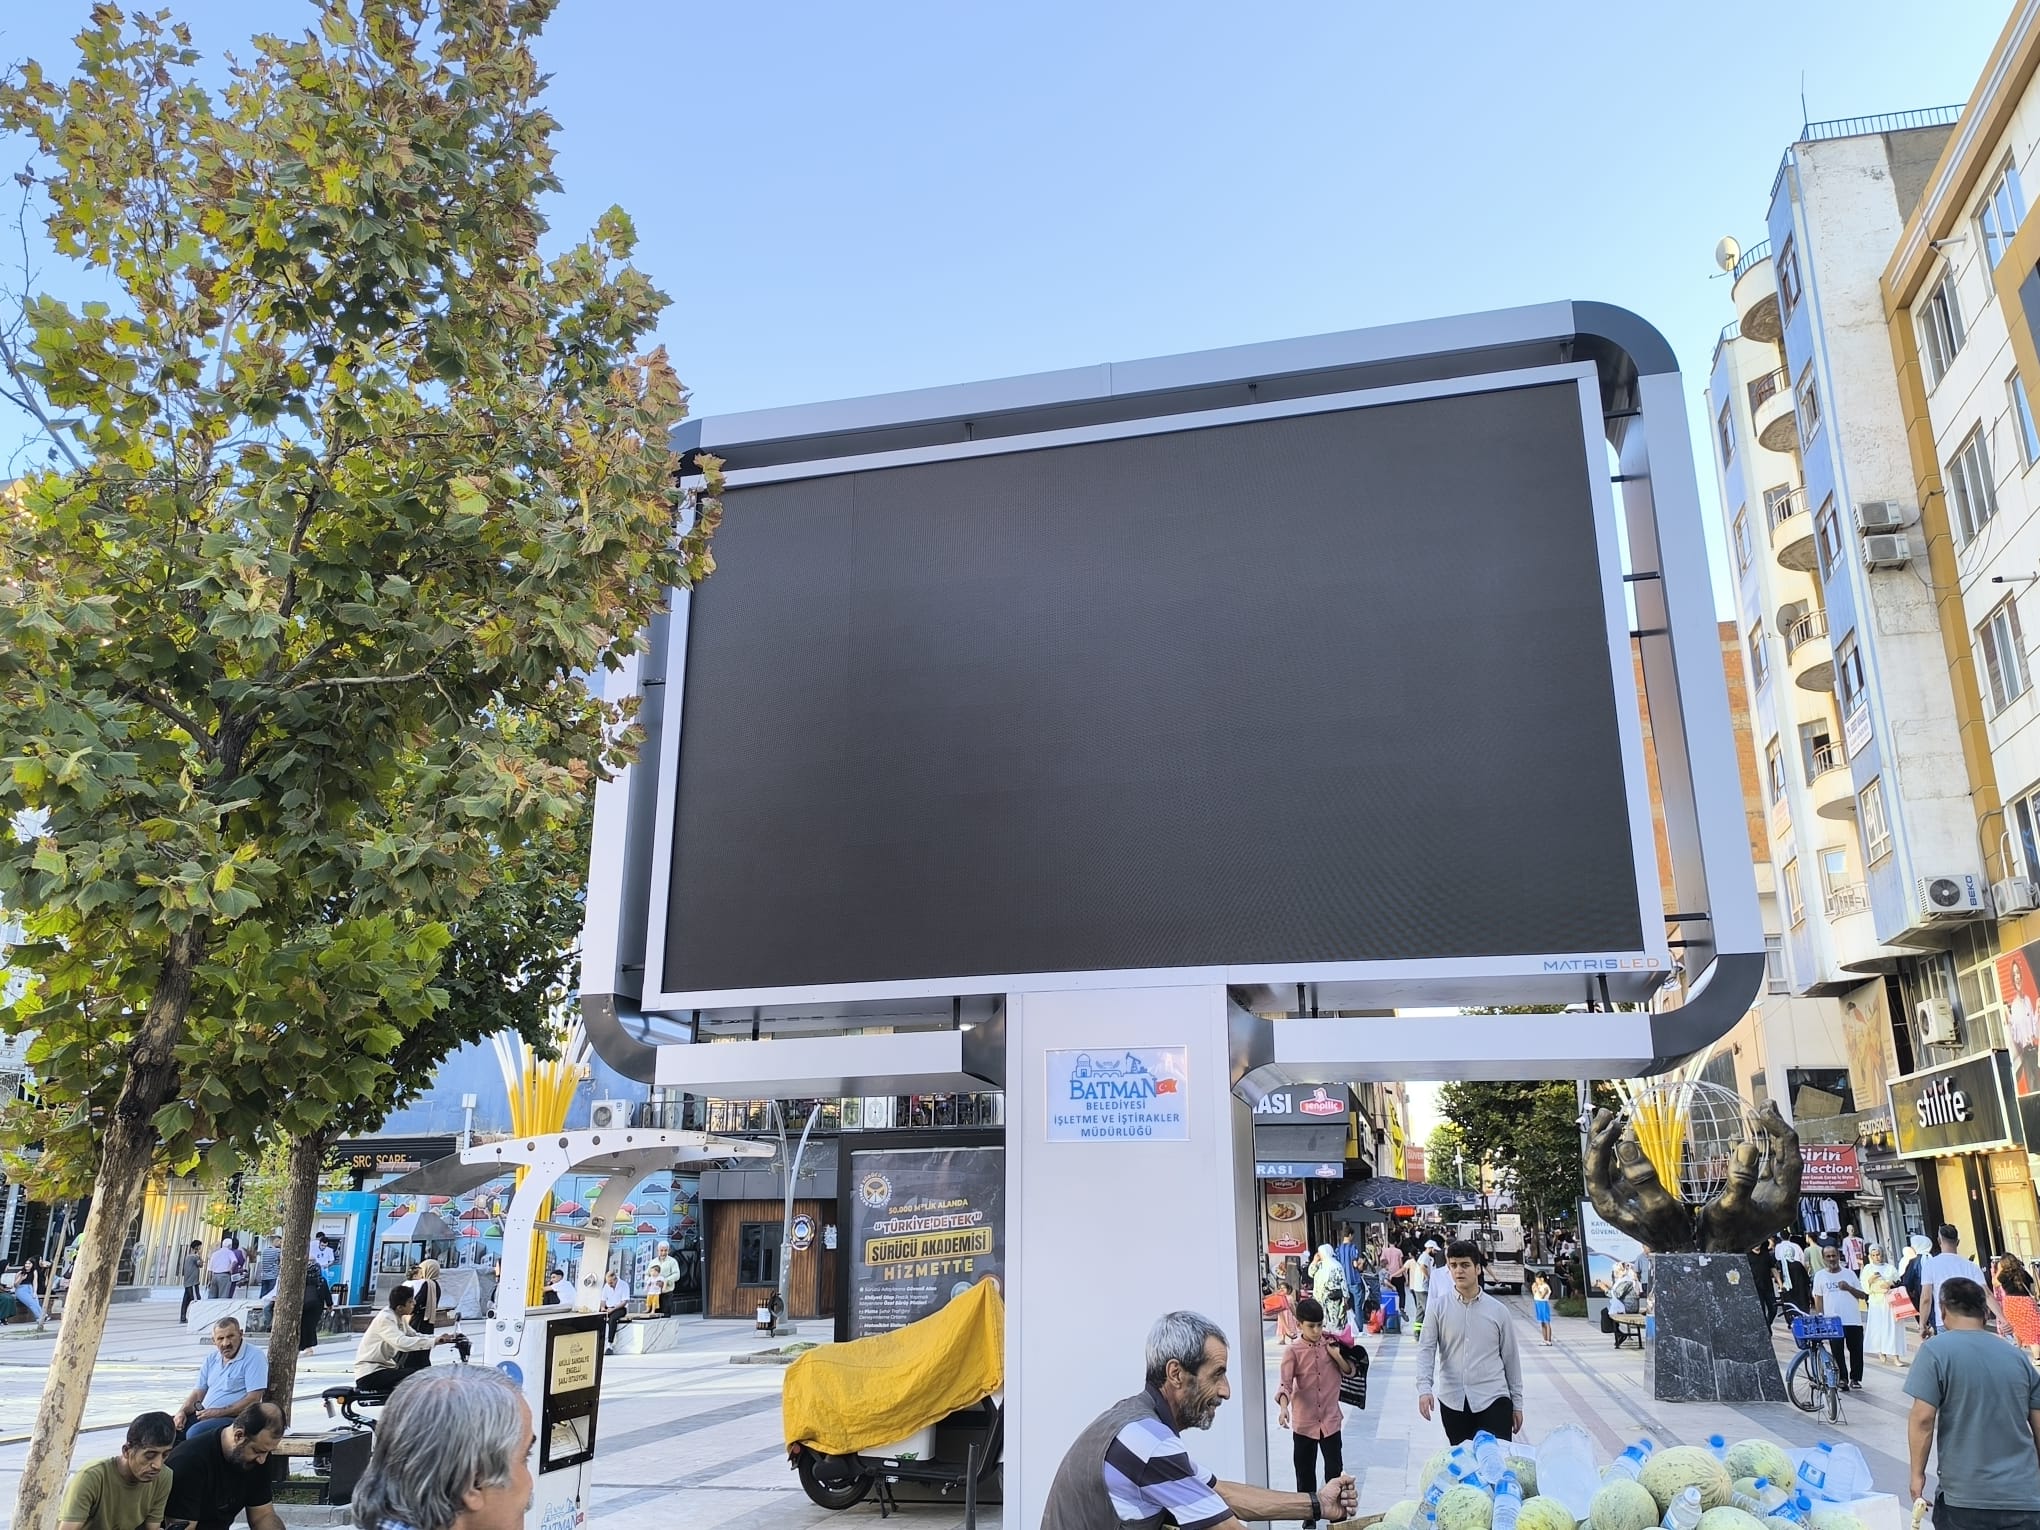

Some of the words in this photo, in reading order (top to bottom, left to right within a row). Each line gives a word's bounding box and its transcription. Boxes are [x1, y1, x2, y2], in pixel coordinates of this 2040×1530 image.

[1965, 875, 1977, 906] BEKO
[1543, 959, 1660, 971] MATRISLED
[1070, 1078, 1157, 1100] BATMAN
[1086, 1100, 1146, 1110] BELEDİYESİ
[1253, 1093, 1292, 1114] ASI
[1916, 1076, 1967, 1128] stilife
[1054, 1114, 1098, 1126] İŞLETME
[1102, 1114, 1115, 1123] VE
[1118, 1112, 1180, 1125] İŞTİRAKLER
[1081, 1126, 1152, 1137] MÜDÜRLÜĞÜ
[352, 1155, 372, 1168] SRC
[1803, 1163, 1853, 1174] llection
[888, 1206, 913, 1215] 50.000
[937, 1199, 969, 1210] ALANDA
[872, 1238, 918, 1262] SÜRÜCÜ
[921, 1231, 987, 1257] AKADEMİSİ
[1826, 1281, 1839, 1291] US
